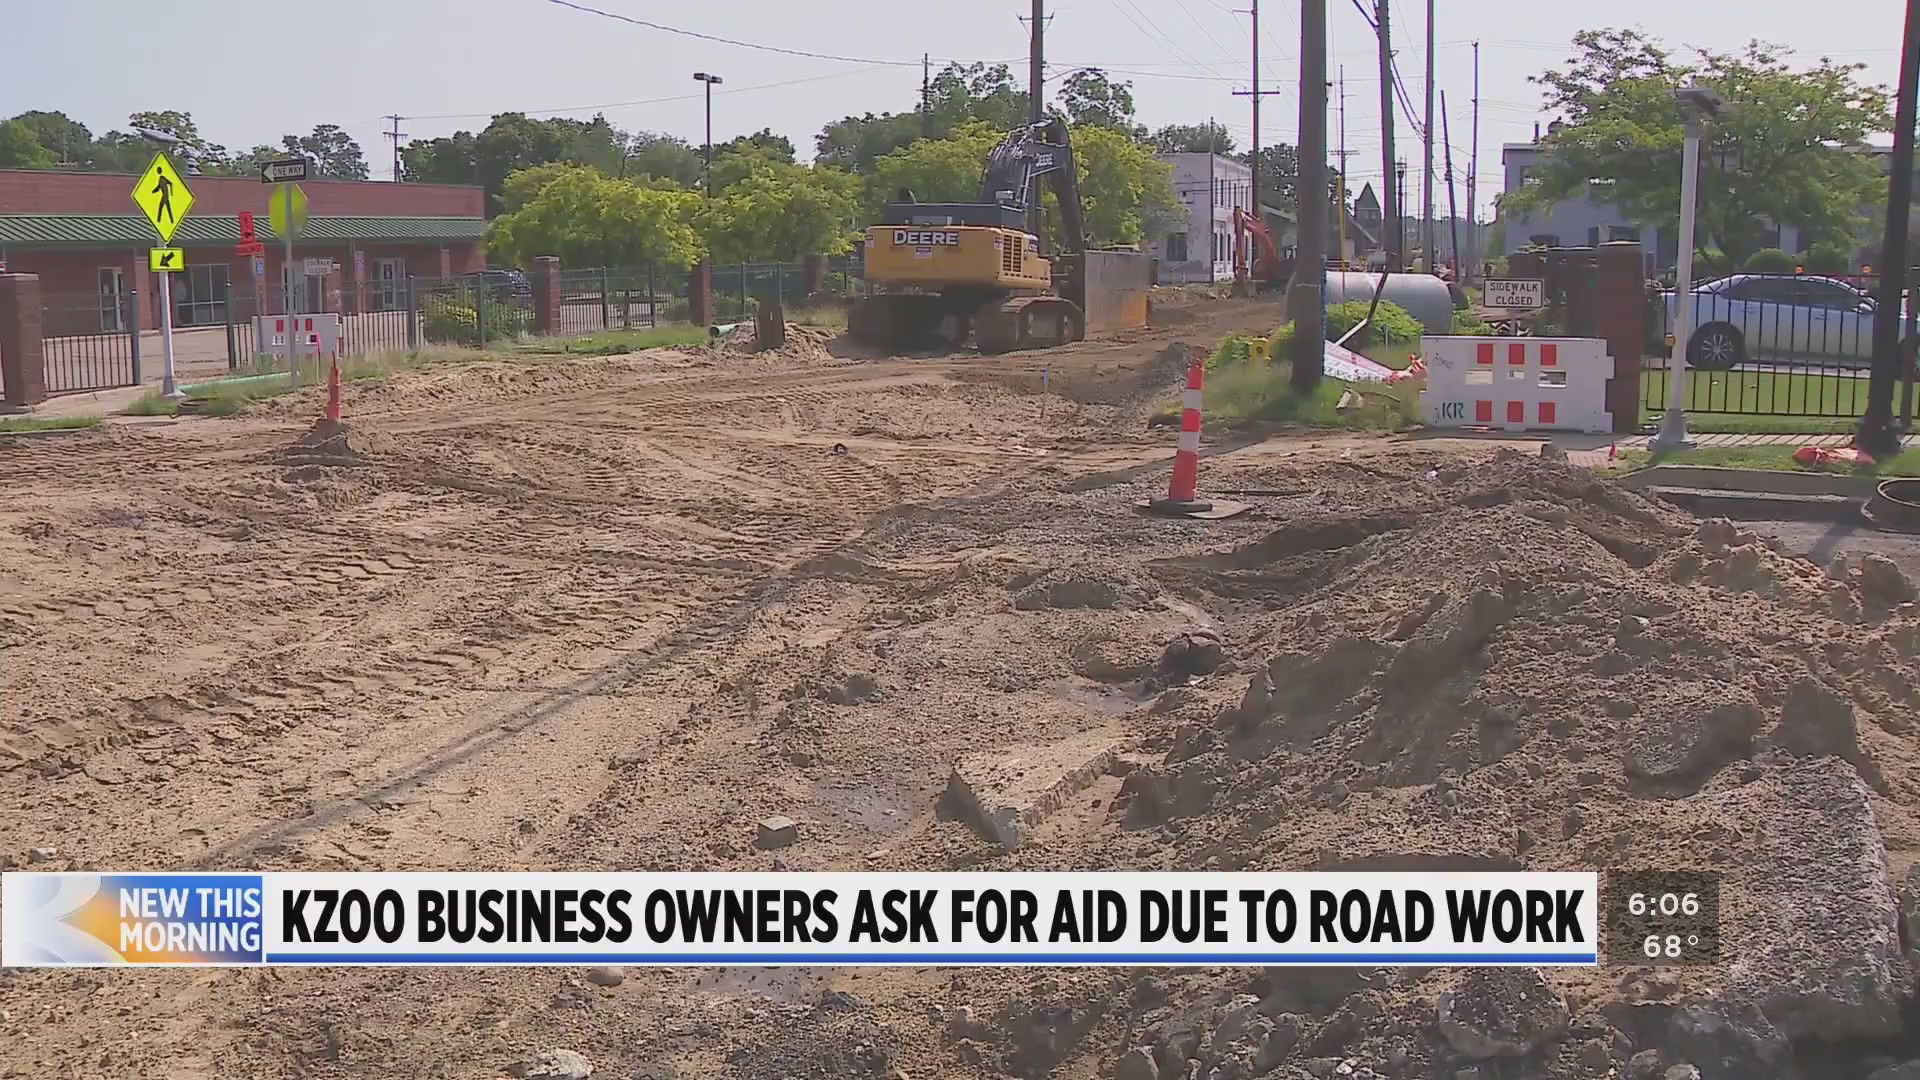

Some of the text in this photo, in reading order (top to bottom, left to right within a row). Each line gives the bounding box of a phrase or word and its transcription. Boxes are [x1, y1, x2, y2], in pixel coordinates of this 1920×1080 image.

[273, 166, 303, 177] ONE WAY
[893, 230, 959, 245] DEERE
[1490, 282, 1538, 292] SIDEWALK
[1496, 296, 1533, 306] CLOSED
[1442, 402, 1464, 419] KR
